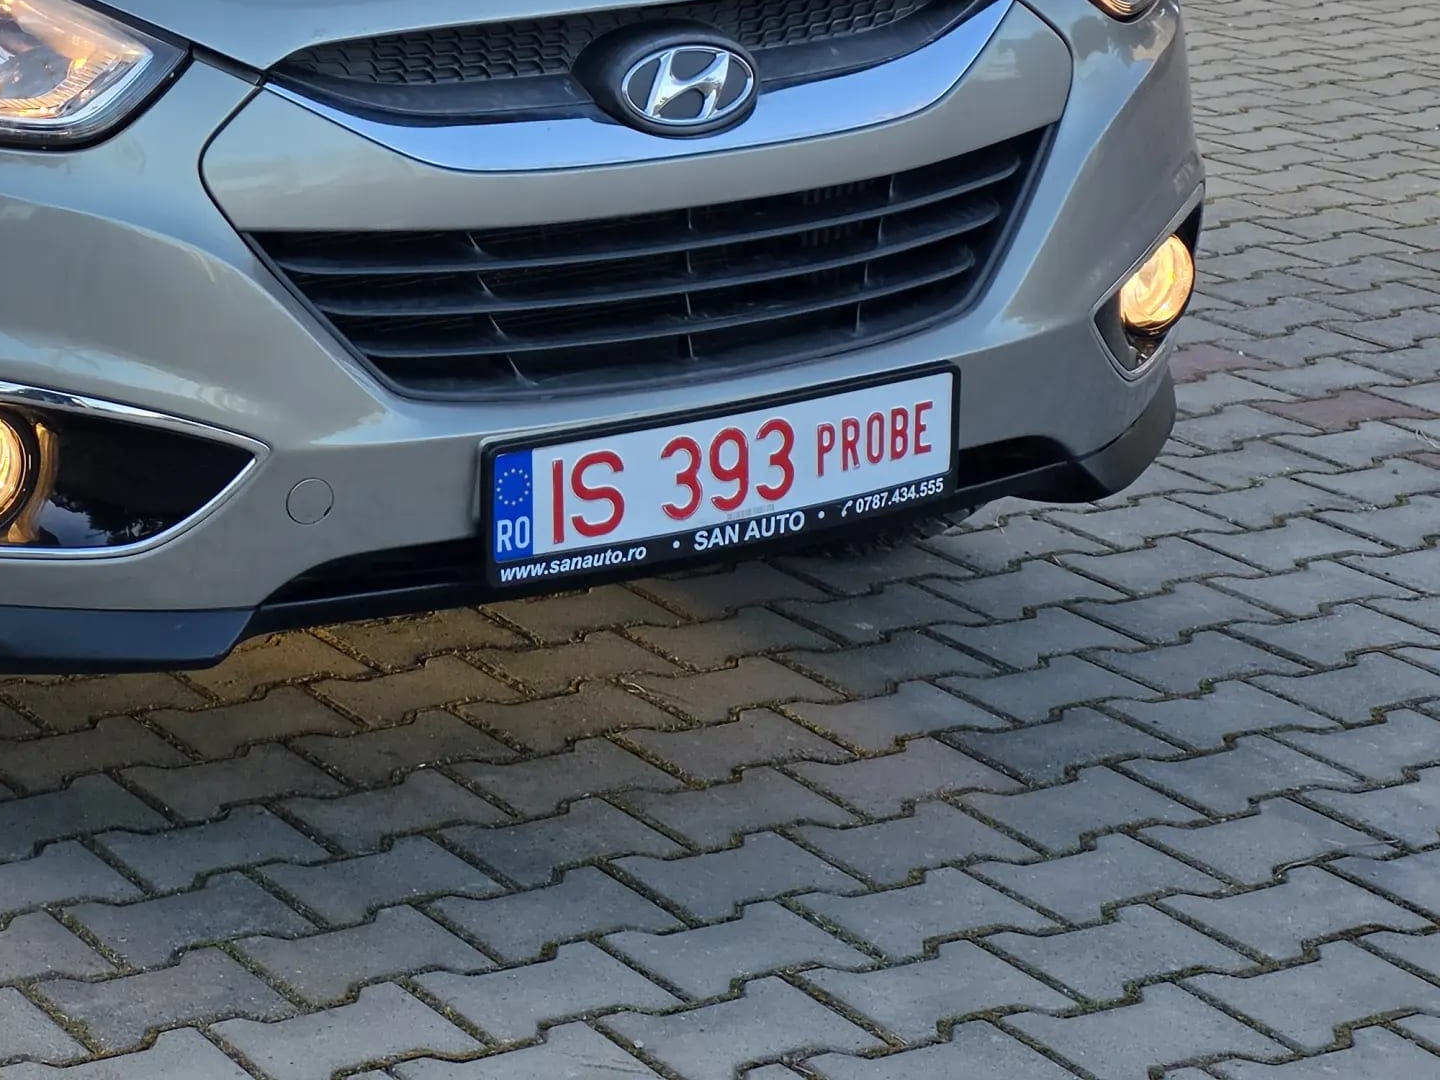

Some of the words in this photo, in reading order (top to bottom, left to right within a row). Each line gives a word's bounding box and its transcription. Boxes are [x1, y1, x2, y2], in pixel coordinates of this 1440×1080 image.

[552, 450, 625, 544] IS
[661, 418, 795, 520] 393
[817, 400, 933, 478] PROBE
[497, 516, 530, 553] RO
[500, 546, 647, 582] www.sanauto.ro
[694, 524, 739, 551] SAN
[744, 511, 805, 541] AUTO
[855, 477, 944, 514] 0787.434.555
